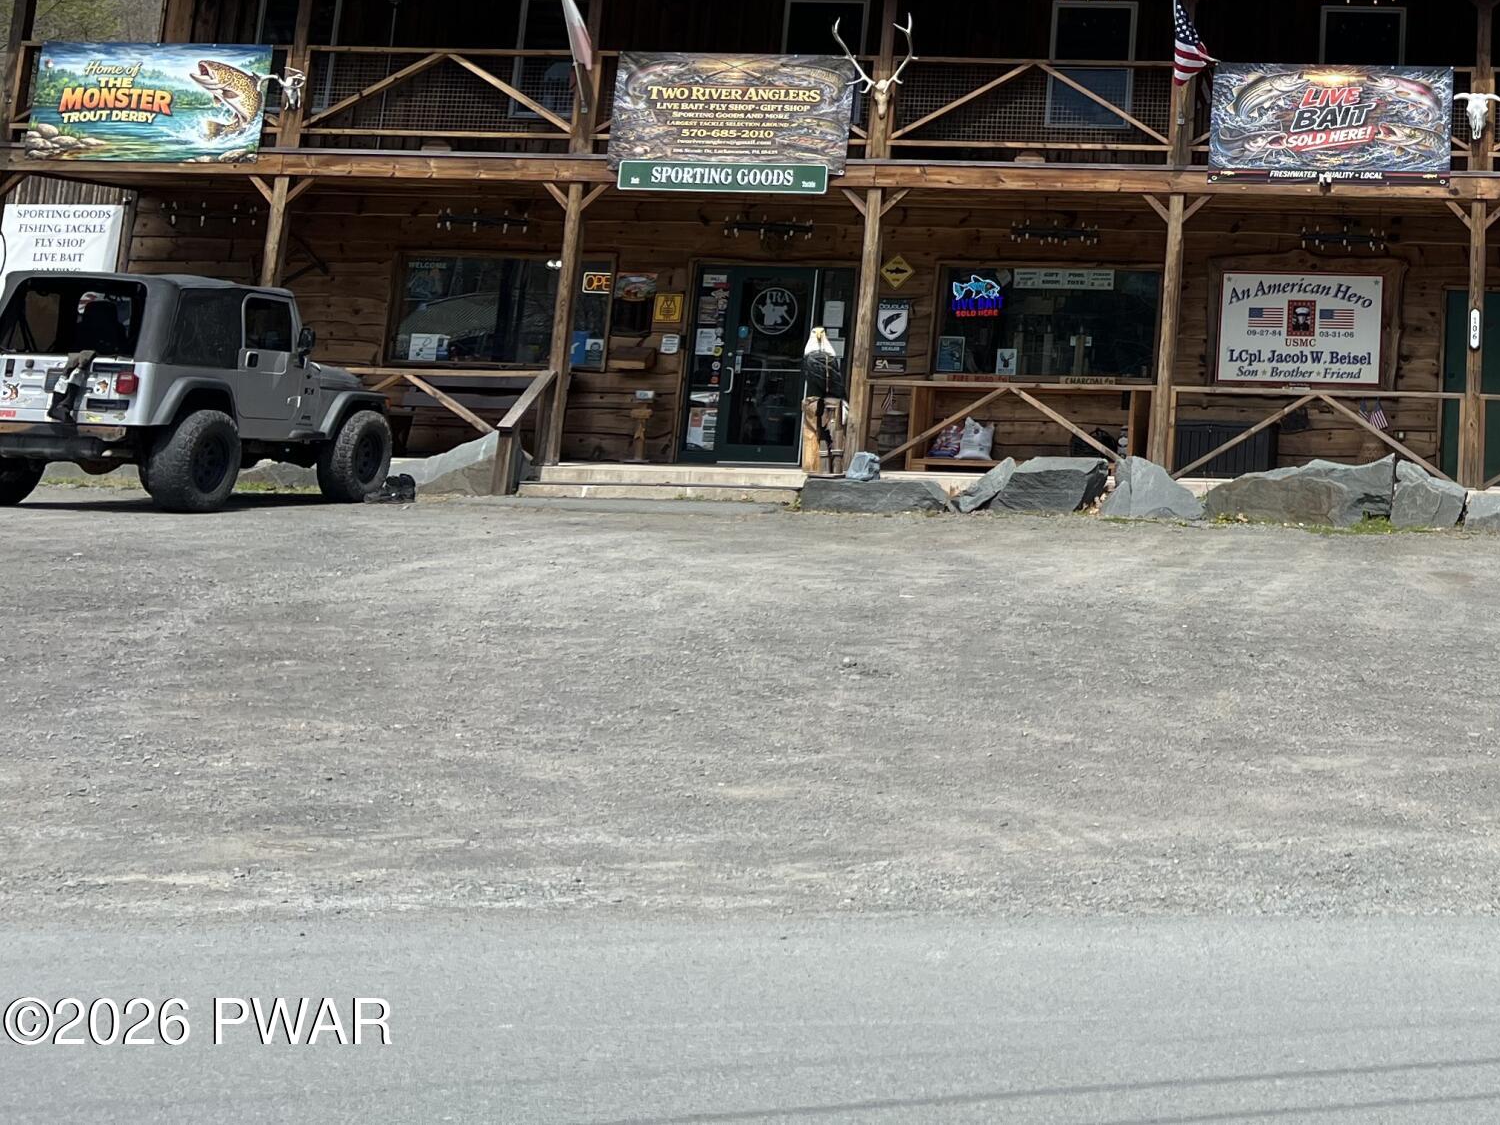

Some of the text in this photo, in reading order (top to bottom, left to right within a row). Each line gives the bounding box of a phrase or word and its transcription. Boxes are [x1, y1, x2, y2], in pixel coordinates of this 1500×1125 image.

[84, 59, 143, 78] Home of
[97, 76, 134, 88] THE
[648, 86, 821, 103] TWO RIVER ANGLERS
[1299, 86, 1363, 108] LIVE
[58, 87, 173, 116] MONSTER
[656, 102, 680, 110] LIVE
[709, 103, 728, 111] FLY
[760, 104, 783, 112] GIFT
[783, 104, 811, 112] SHOP
[61, 110, 156, 124] TROUT DERBY
[1290, 103, 1377, 132] BAIT
[681, 129, 774, 138] 570-685-2010
[1287, 126, 1373, 147] SOLD HERE!
[651, 166, 794, 186] SPORTING GOODS
[1270, 170, 1318, 179] FRESHWATER
[17, 209, 112, 219] SPORTING GOODS
[18, 223, 106, 234] FISHING TACKLE
[35, 238, 86, 248] FLY SHOP
[33, 253, 84, 262] LIVE BAIT
[408, 261, 447, 269] WELCOME
[585, 275, 610, 291] OPE
[1228, 278, 1373, 309] An American Hero
[879, 303, 909, 311] DOUGLAS
[952, 296, 1004, 310] LIVE BAIT
[955, 309, 999, 317] SOLD HERE
[1246, 329, 1355, 338] 09-27-84 03-31-06
[1285, 338, 1316, 347] USMC
[1228, 348, 1372, 366] LCpl. Jacob W. Beisel
[1236, 366, 1362, 379] Son Brother Friend
